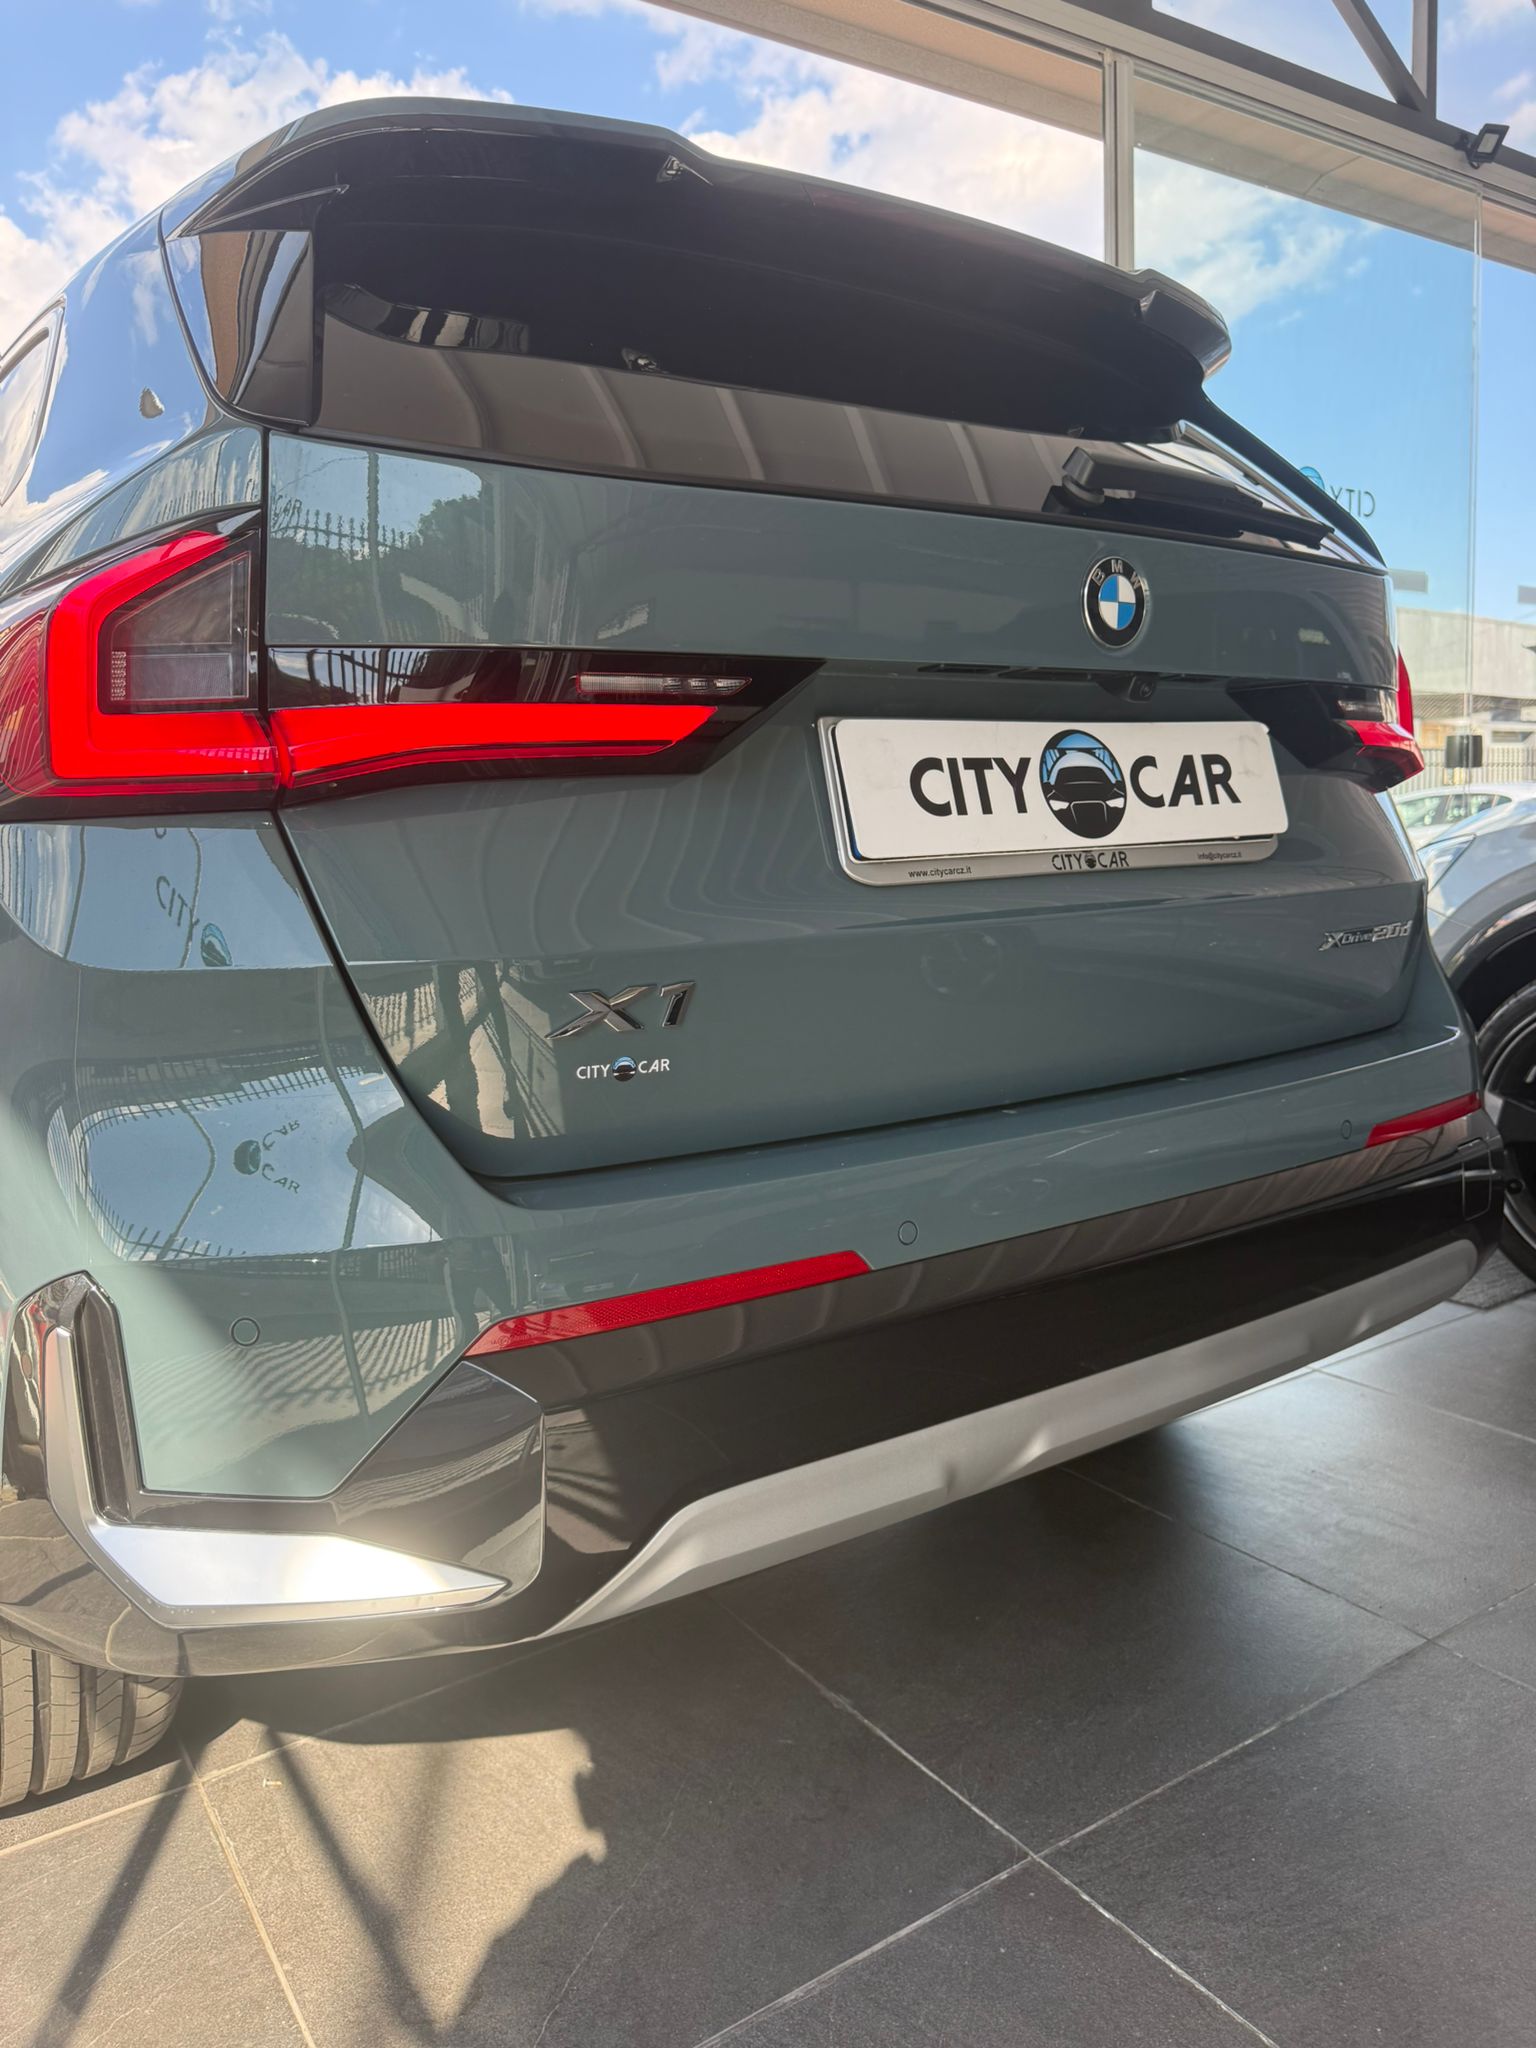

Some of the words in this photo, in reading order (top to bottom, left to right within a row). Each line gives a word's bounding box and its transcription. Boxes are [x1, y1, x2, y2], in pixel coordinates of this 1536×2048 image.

[1091, 559, 1141, 589] BMW
[909, 757, 1032, 817] CITY
[1130, 754, 1242, 808] CAR
[908, 866, 972, 878] www.citycarcz.it
[1051, 853, 1082, 870] CITY
[1097, 850, 1129, 868] CAR
[544, 980, 697, 1039] X1
[576, 1063, 611, 1079] CITY
[638, 1058, 670, 1074] CAR
